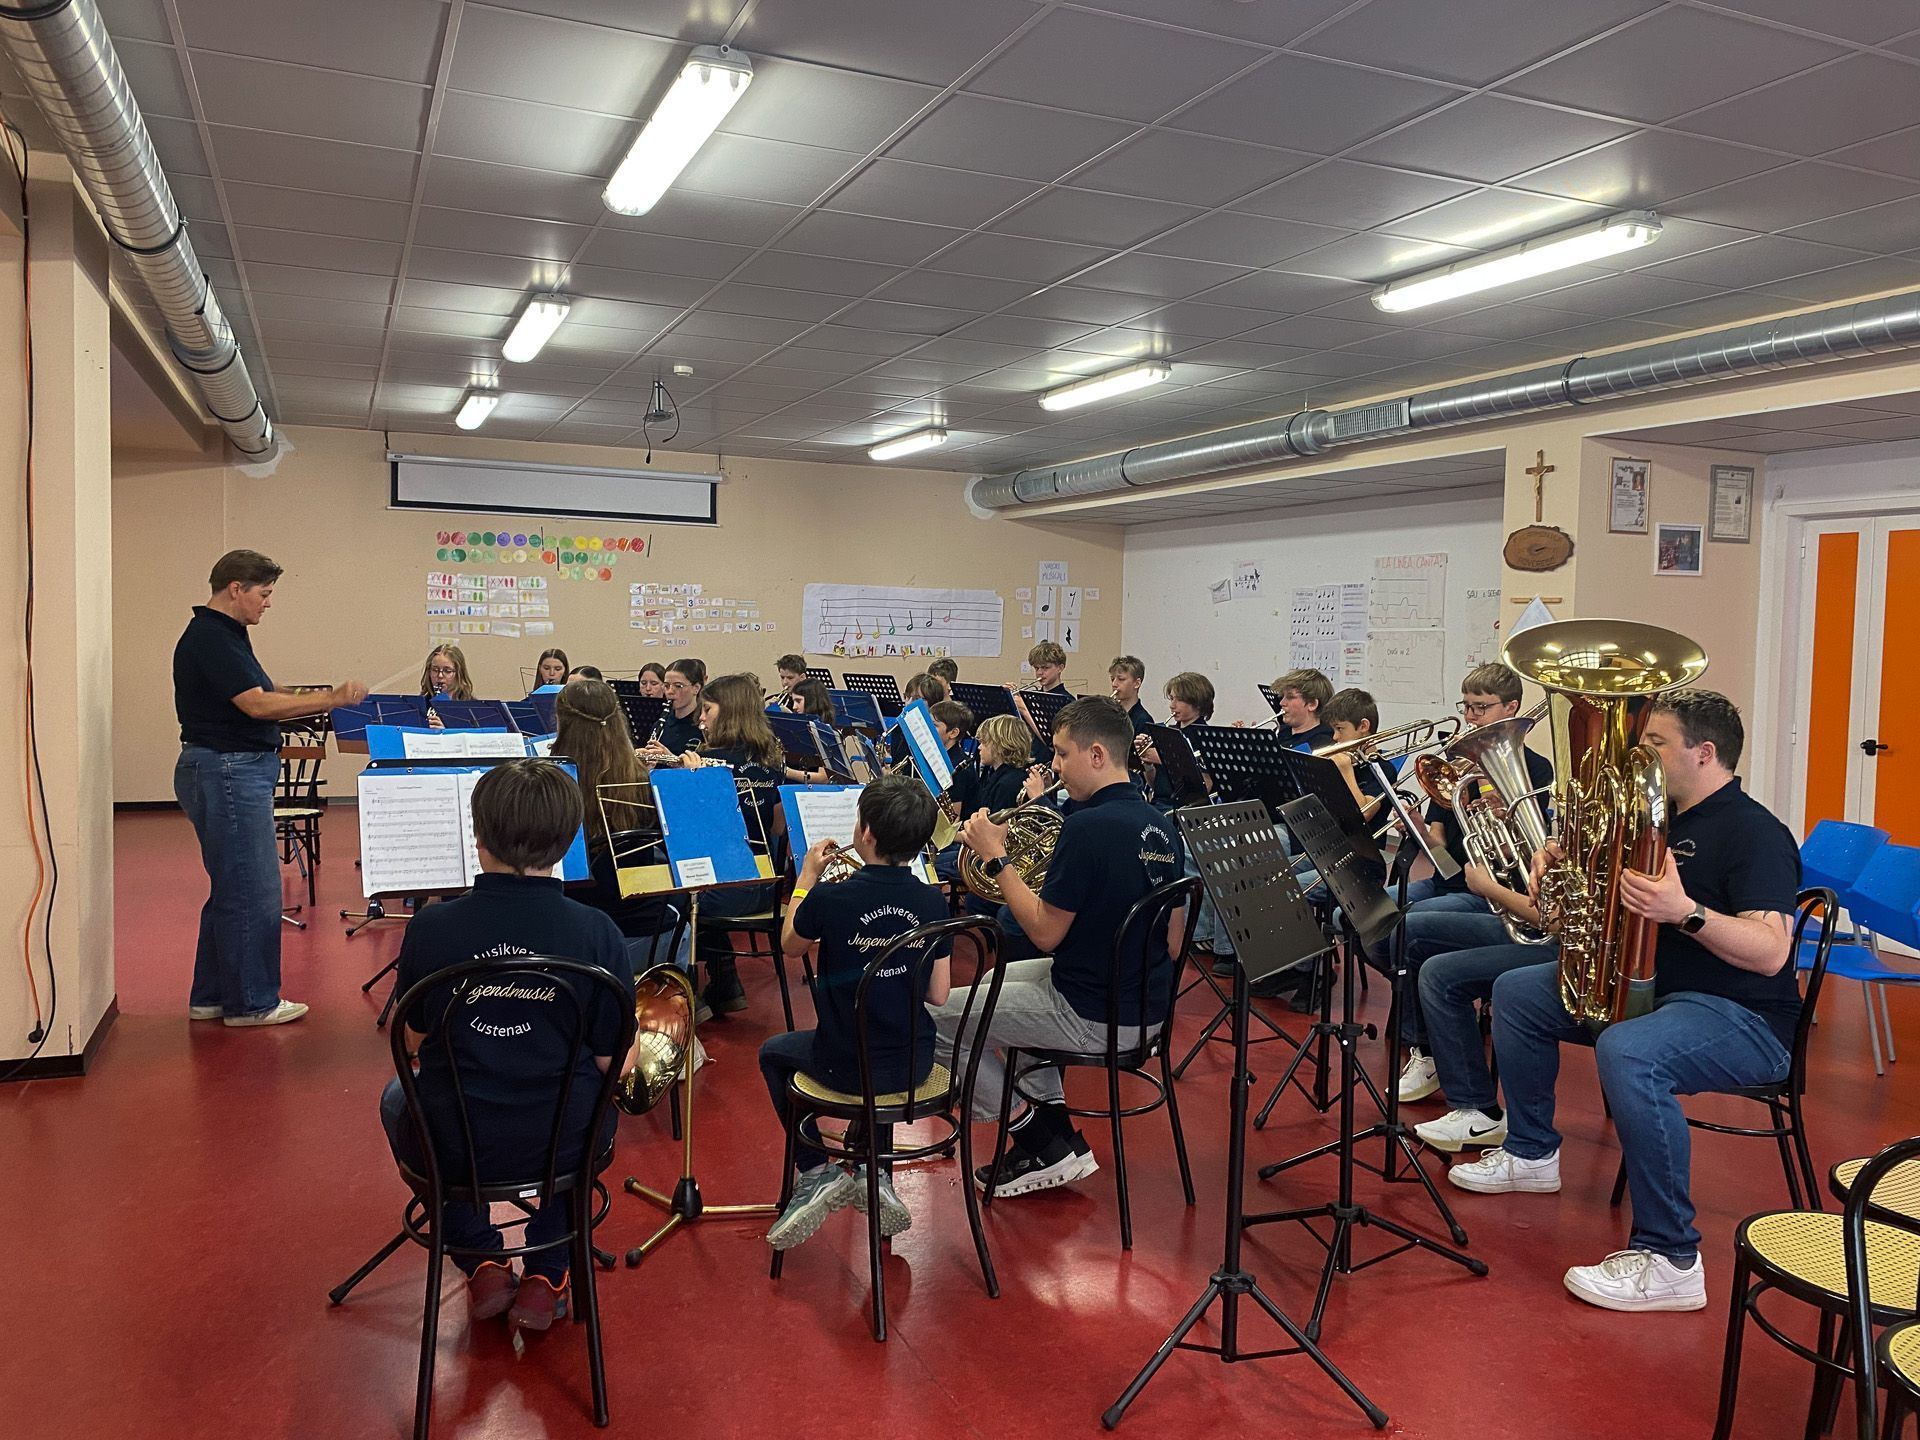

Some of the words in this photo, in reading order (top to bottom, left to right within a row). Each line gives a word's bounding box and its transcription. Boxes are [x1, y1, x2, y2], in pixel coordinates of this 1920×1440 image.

[738, 761, 770, 775] Musikvein
[859, 904, 921, 928] Musikverein
[847, 932, 926, 954] Jugendsik
[452, 978, 556, 1005] Jgendmusik
[469, 1016, 532, 1038] Lustenau
